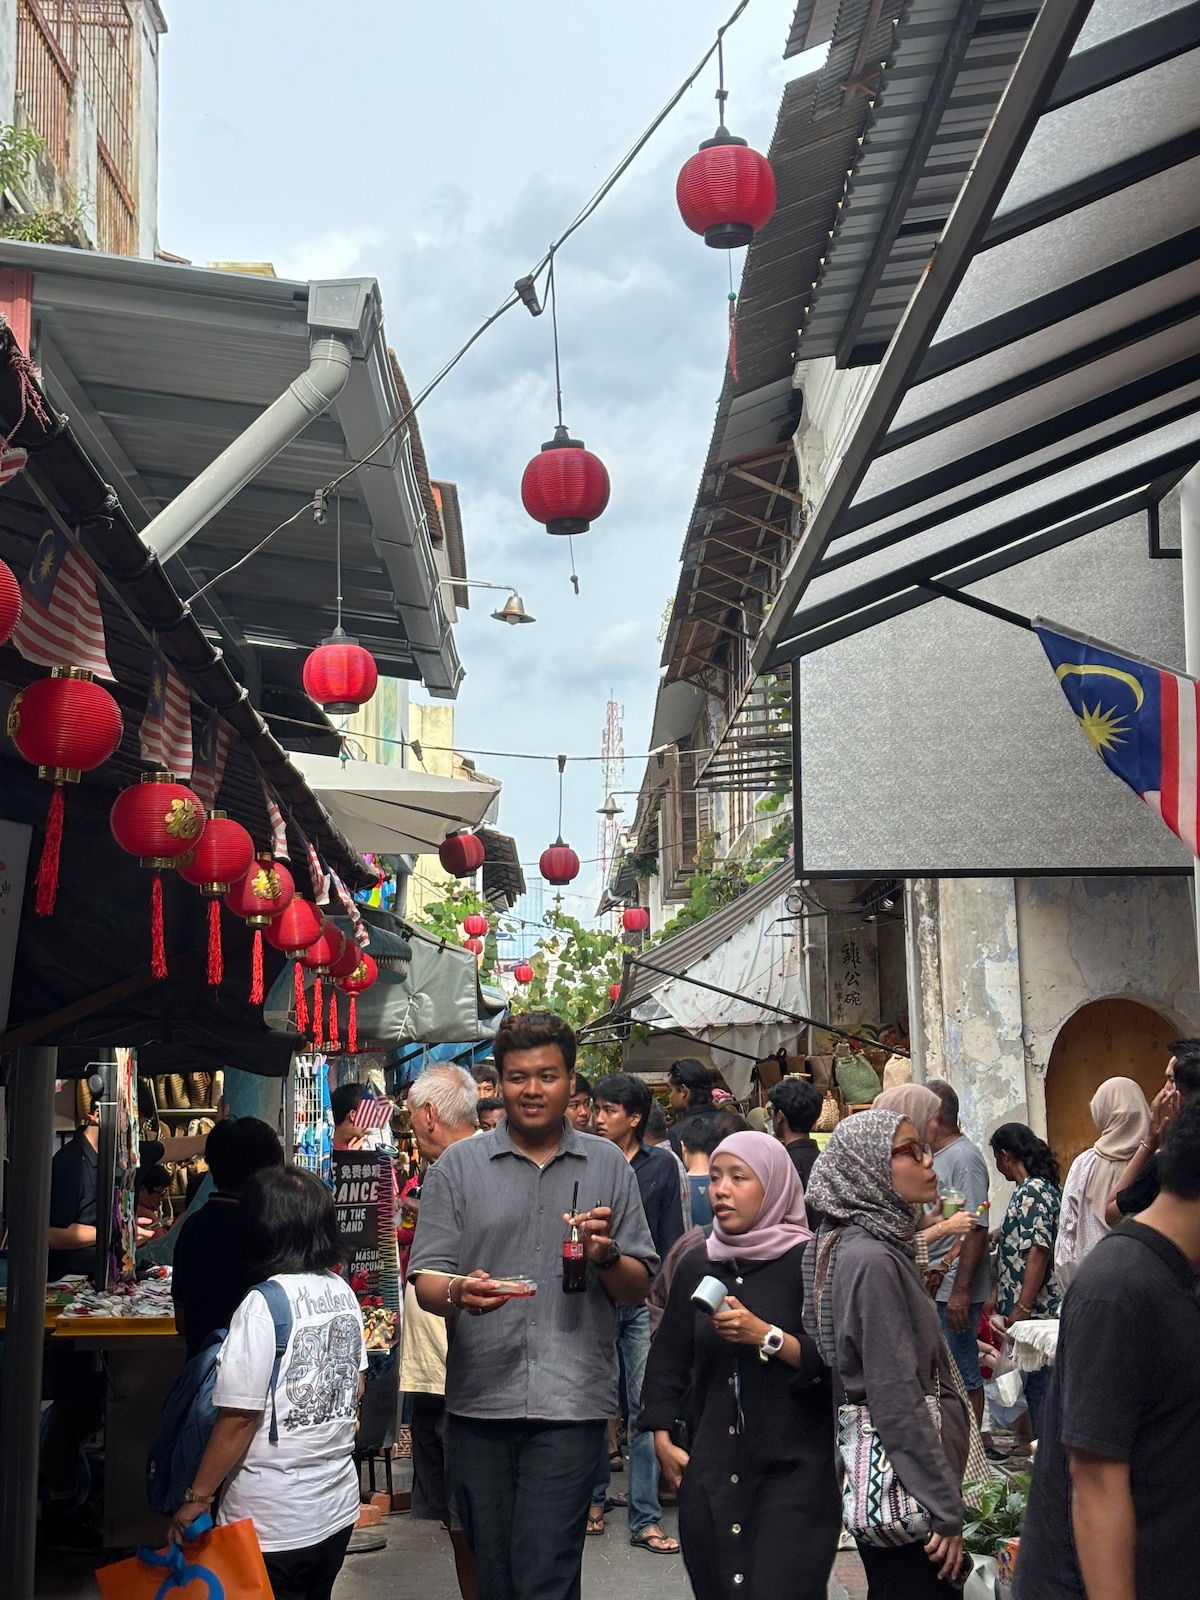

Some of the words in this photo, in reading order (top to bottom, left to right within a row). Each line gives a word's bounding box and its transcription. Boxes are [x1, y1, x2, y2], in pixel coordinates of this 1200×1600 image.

[841, 940, 862, 1006] 雞公碗
[337, 1209, 347, 1221] IN
[350, 1208, 367, 1220] THE
[340, 1220, 364, 1233] SAND
[355, 1250, 380, 1261] MASUK
[292, 1283, 358, 1319] Thailand
